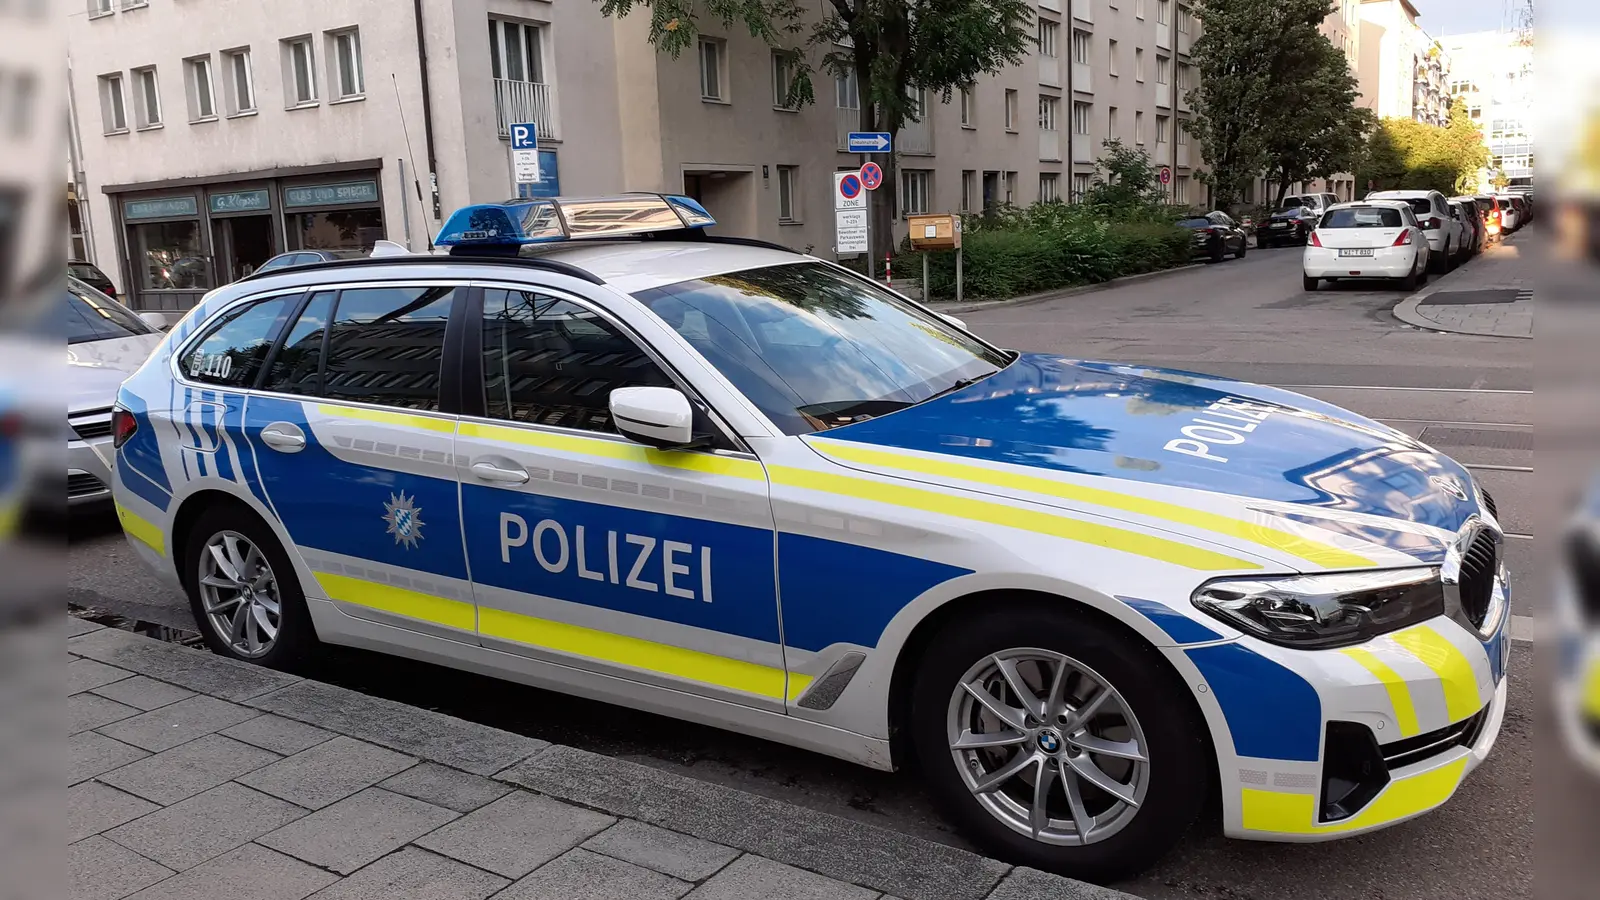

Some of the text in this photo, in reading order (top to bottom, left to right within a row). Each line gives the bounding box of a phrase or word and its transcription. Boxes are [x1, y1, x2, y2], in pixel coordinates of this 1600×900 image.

[514, 126, 529, 147] P
[289, 185, 373, 201] GLAS UND SPIEGEL
[204, 354, 232, 379] 110
[500, 511, 713, 603] POLIZEI
